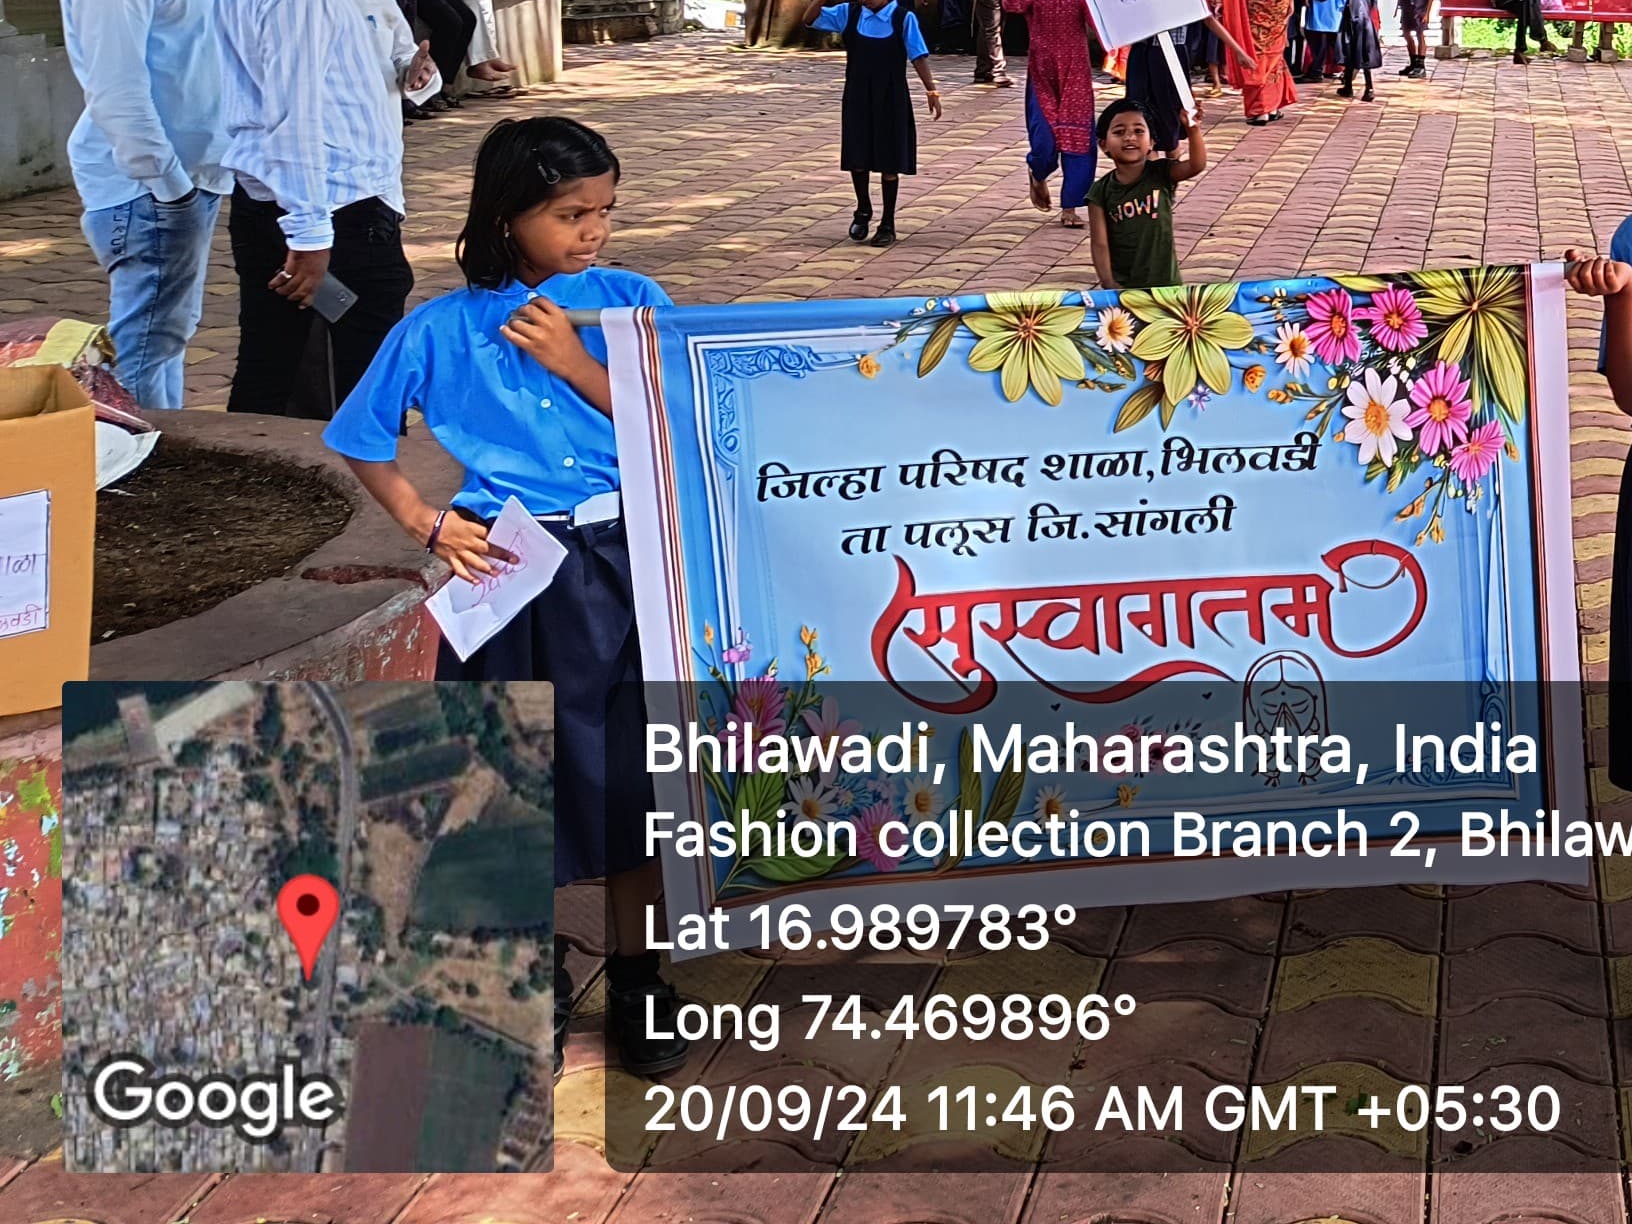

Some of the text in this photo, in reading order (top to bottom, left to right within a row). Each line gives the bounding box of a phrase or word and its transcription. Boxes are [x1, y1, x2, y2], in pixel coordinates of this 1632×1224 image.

[1108, 189, 1161, 224] WOW!
[756, 461, 887, 503] जिल्हा
[898, 448, 1030, 490] परिषद
[840, 525, 893, 556] ता
[903, 516, 1016, 557] पलूस
